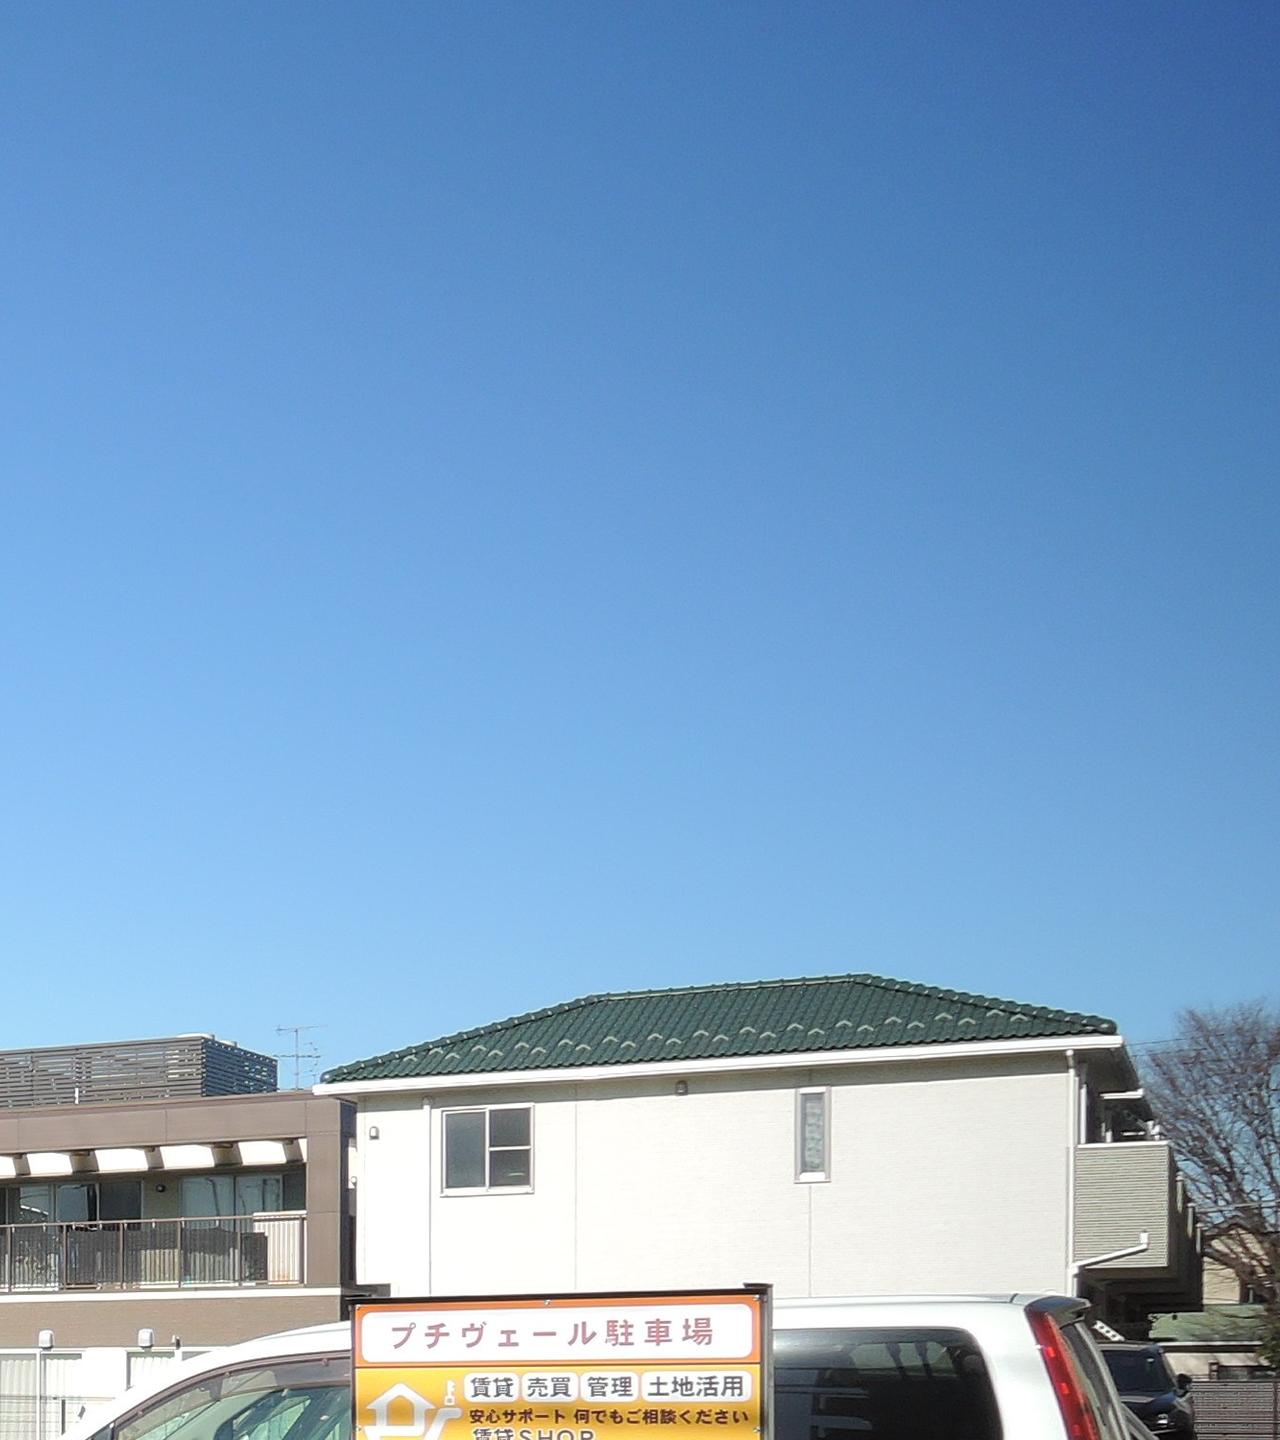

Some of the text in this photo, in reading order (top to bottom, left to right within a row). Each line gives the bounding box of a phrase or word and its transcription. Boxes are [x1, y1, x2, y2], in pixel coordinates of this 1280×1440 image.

[391, 1317, 713, 1349] プチヴェール駐車場
[471, 1375, 744, 1398] 賃貸 売買 管理 土地活用
[469, 1408, 749, 1425] 安心サポート 何でもご相談ください
